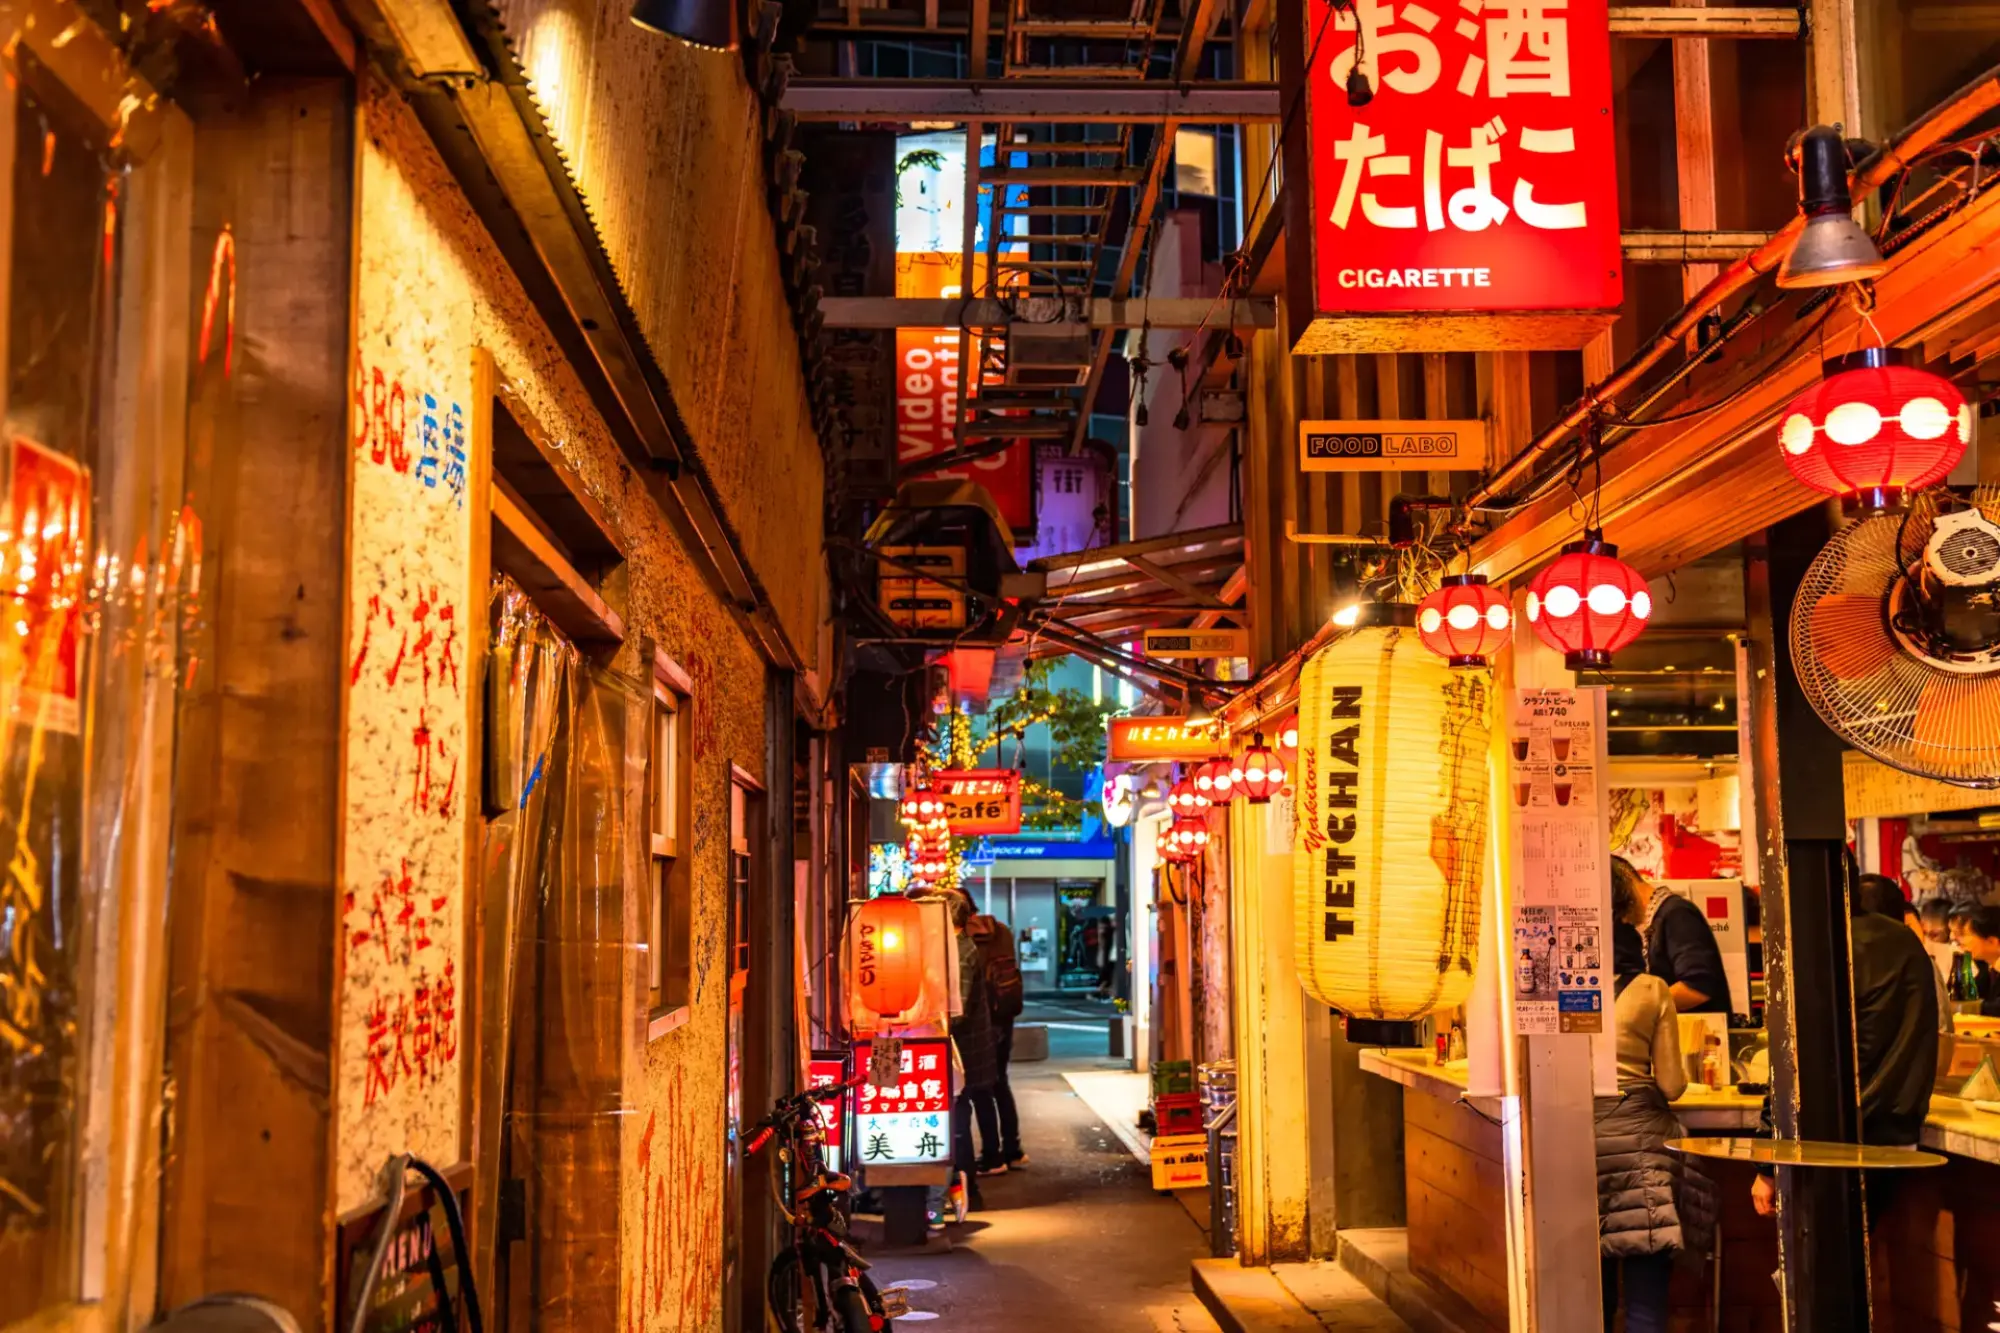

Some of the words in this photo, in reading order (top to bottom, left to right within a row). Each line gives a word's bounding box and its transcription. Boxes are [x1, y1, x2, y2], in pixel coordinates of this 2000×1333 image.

[1329, 0, 1571, 98] お酒
[1329, 115, 1587, 232] たばこ
[1338, 268, 1491, 288] CIGARETTE
[899, 348, 934, 460] Video
[1311, 437, 1378, 454] FOOD
[1385, 437, 1453, 454] LABO
[945, 801, 1000, 820] Café
[1304, 748, 1327, 854] Yakitori
[1325, 686, 1362, 941] TETCHAN
[863, 1132, 945, 1161] 美舟
